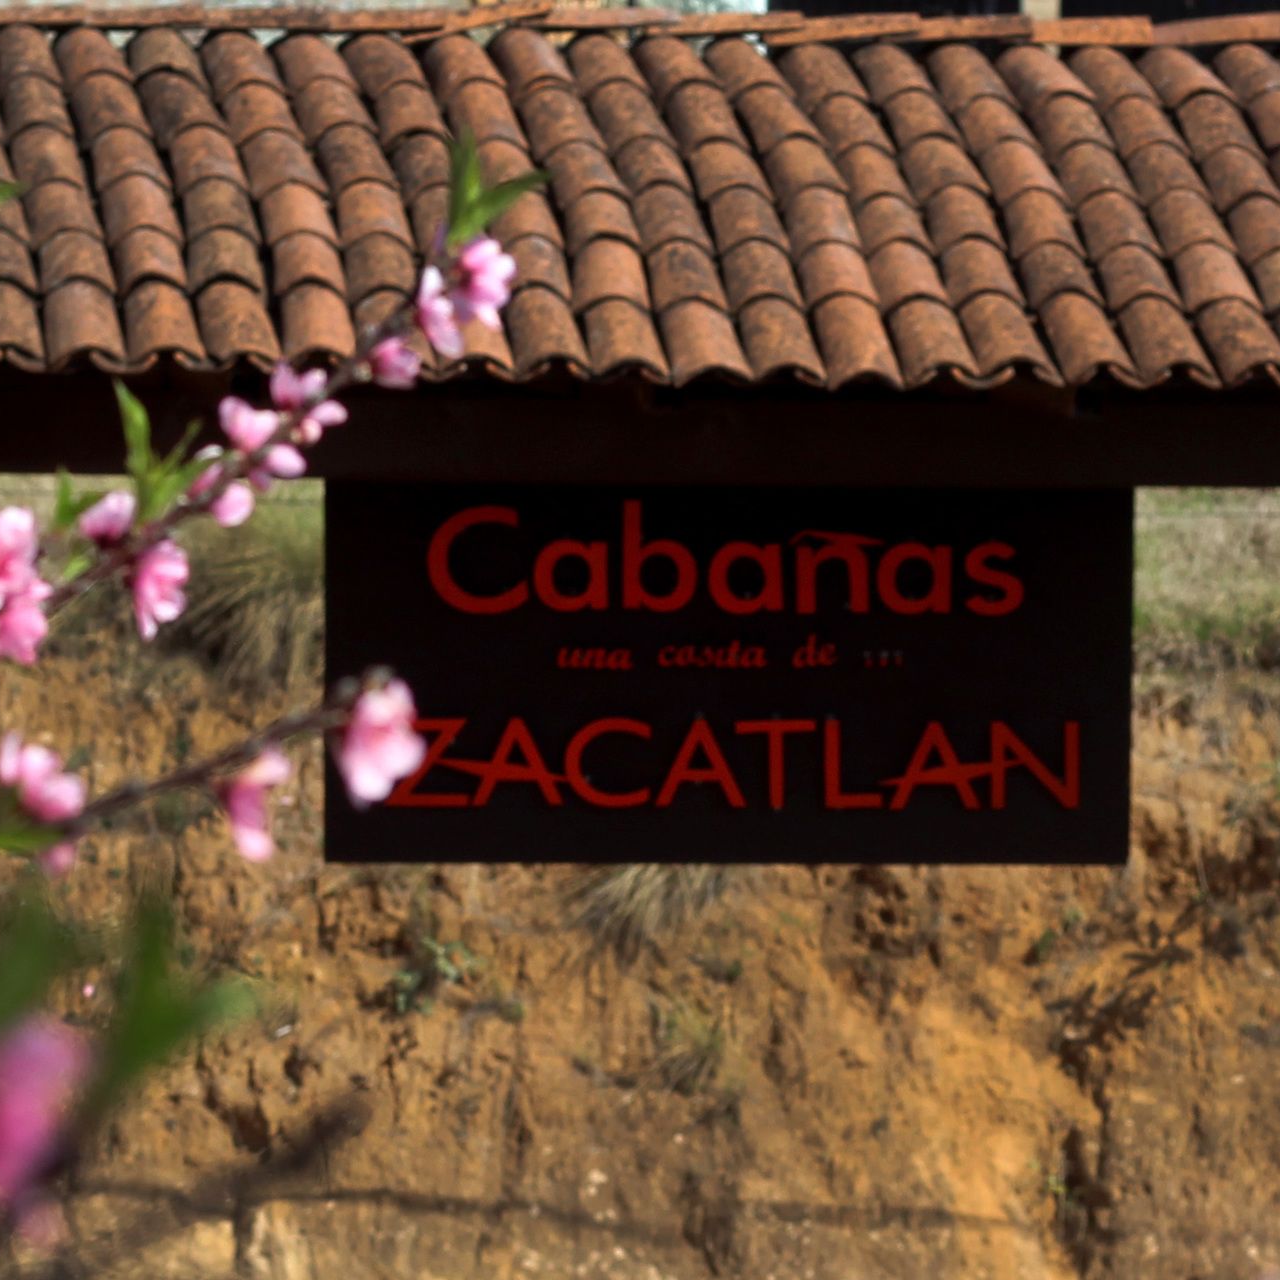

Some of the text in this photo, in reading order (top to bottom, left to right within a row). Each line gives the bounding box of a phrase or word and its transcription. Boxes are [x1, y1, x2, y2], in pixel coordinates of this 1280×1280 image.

[557, 646, 632, 670] una
[791, 634, 836, 667] de
[384, 716, 1080, 810] ZACATLAN
